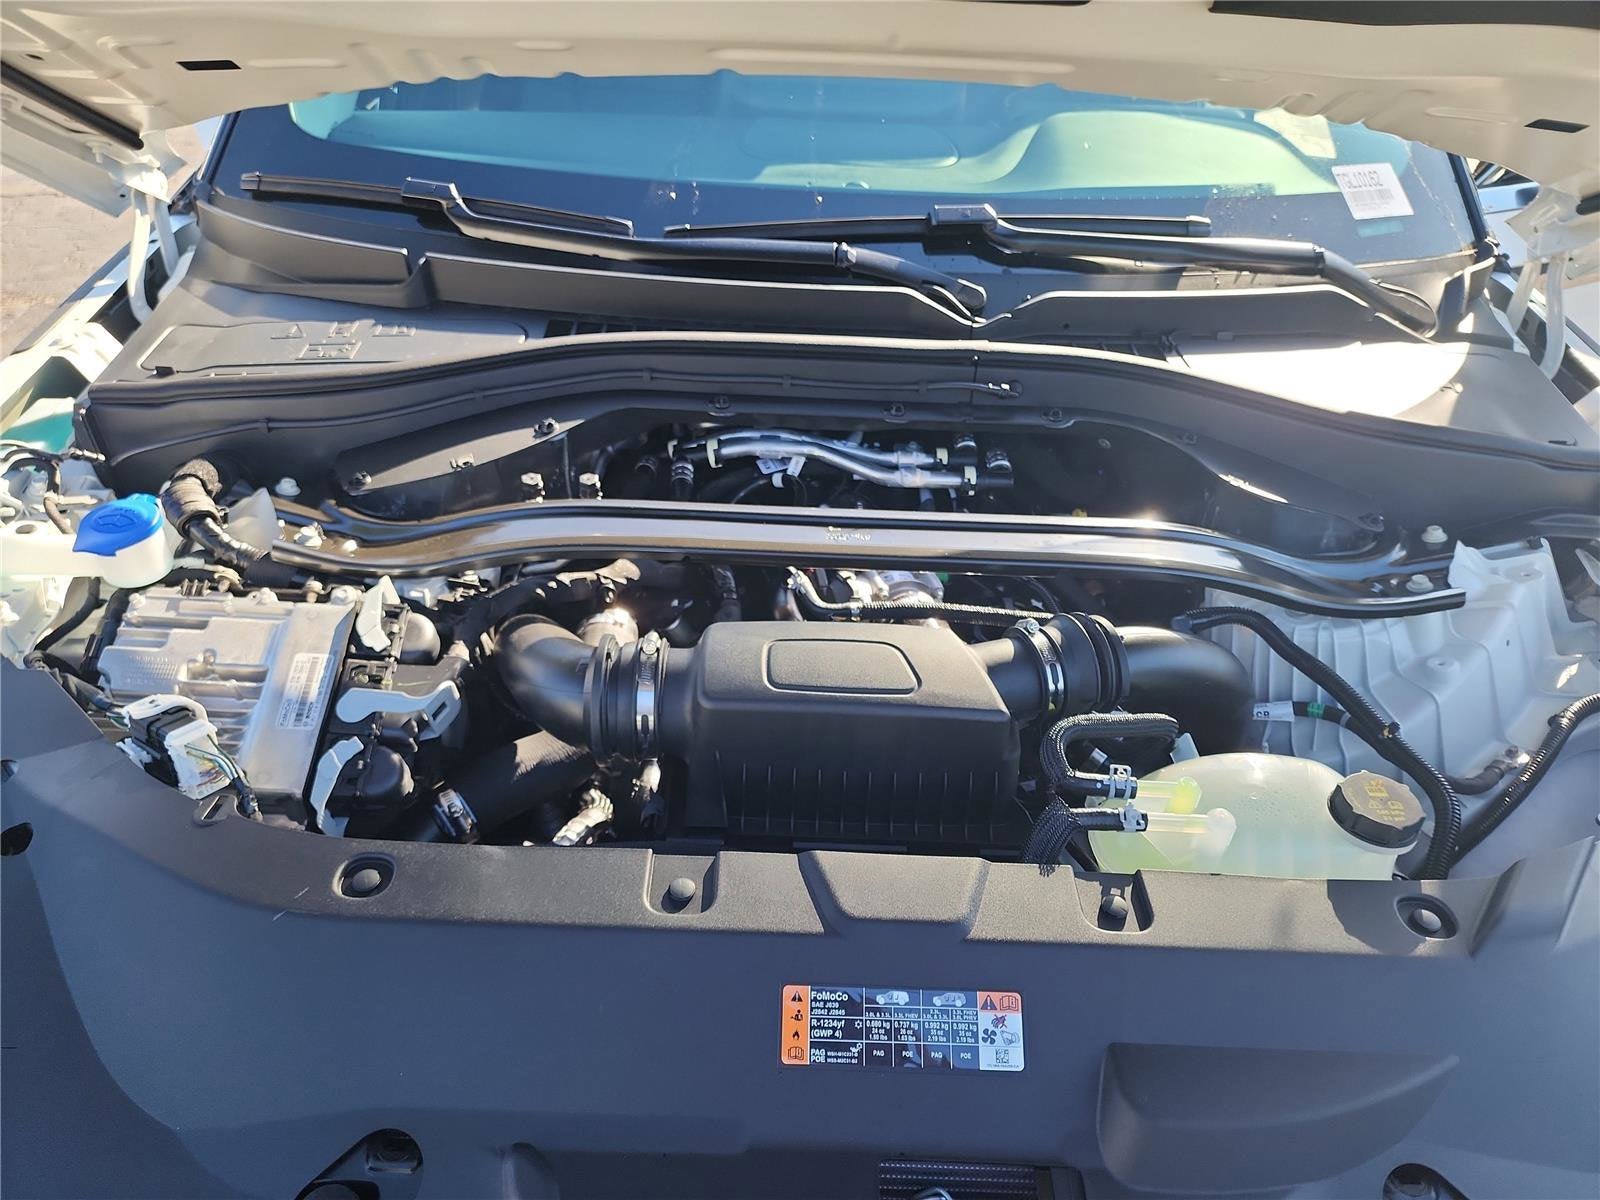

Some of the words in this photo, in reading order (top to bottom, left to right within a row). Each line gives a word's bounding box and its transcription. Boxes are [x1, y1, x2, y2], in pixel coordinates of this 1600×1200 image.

[811, 991, 848, 1001] FoMoCo
[812, 1019, 845, 1029] R-1234yf
[883, 1021, 890, 1029] kg
[911, 1021, 918, 1030] kg
[941, 1022, 948, 1030] kg
[969, 1023, 977, 1032] kg
[811, 1029, 833, 1038] (GWP
[834, 1030, 842, 1039] 4)
